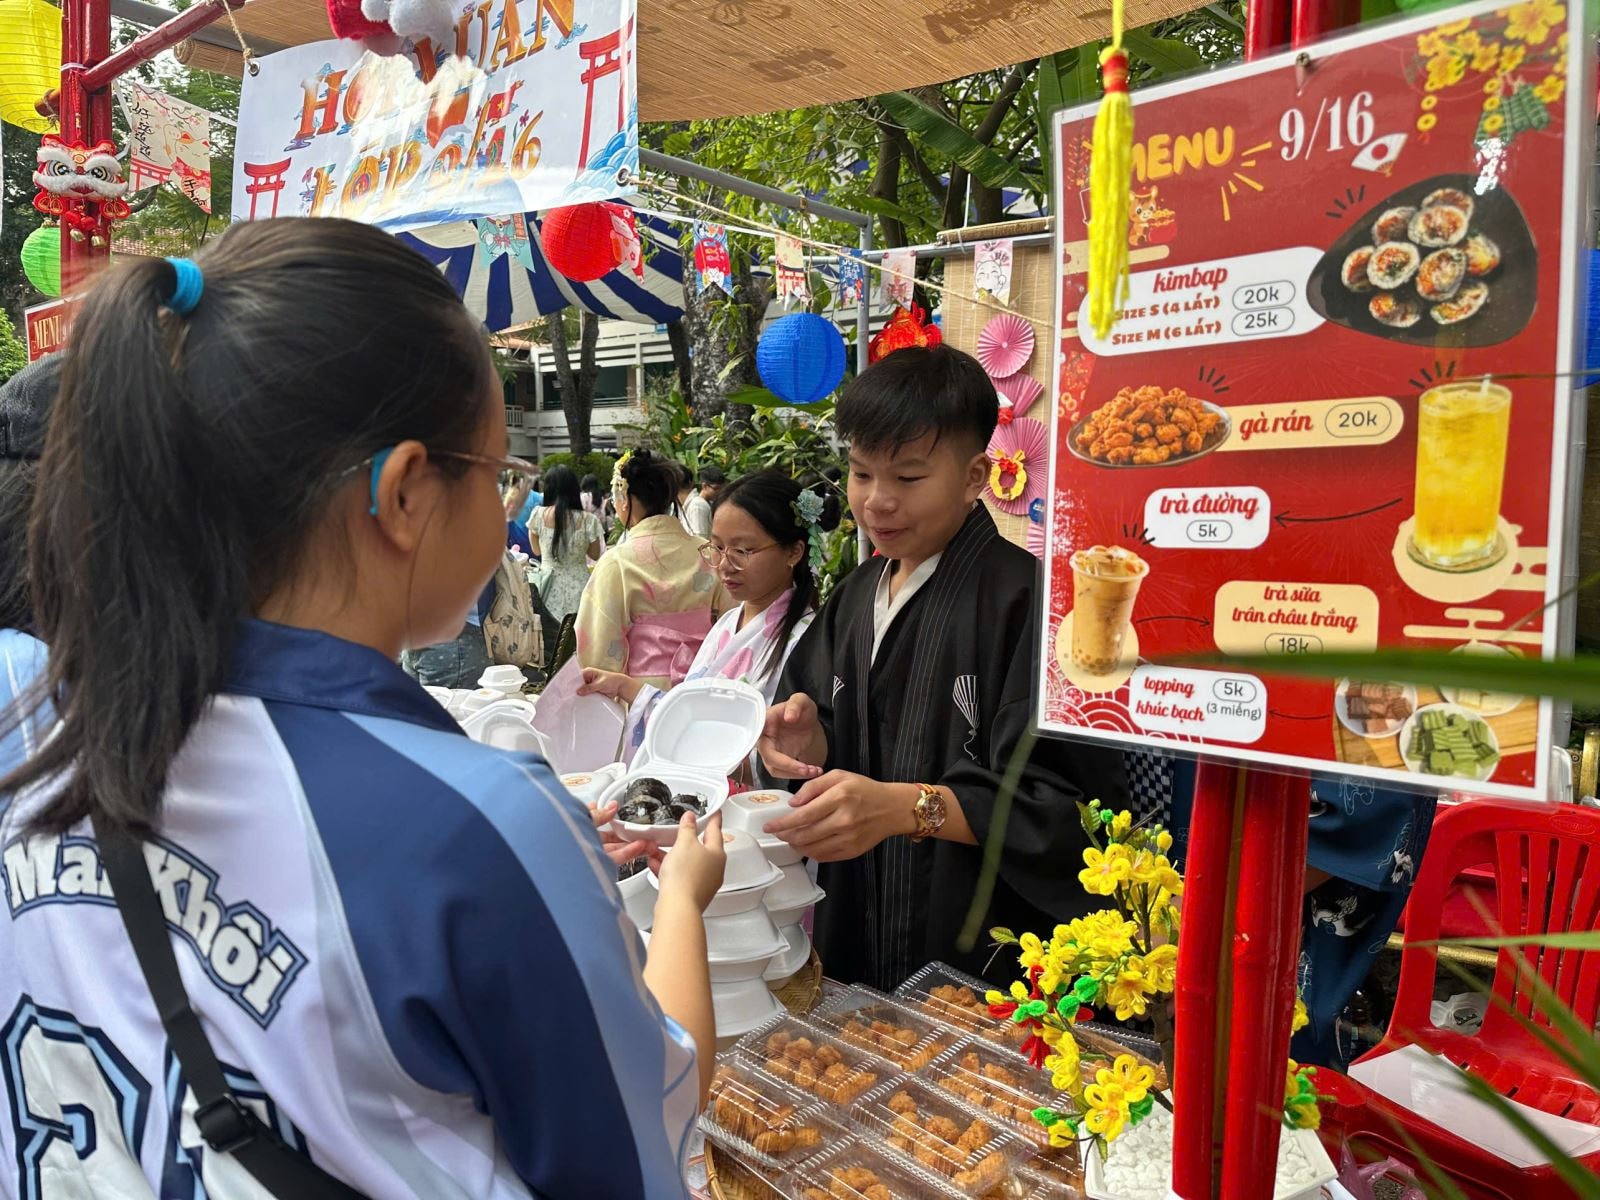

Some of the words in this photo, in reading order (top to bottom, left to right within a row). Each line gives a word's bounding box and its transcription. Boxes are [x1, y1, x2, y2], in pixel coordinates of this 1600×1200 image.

[1279, 91, 1375, 161] 9/16
[1152, 266, 1229, 293] kimbap
[1113, 308, 1146, 321] SIZE
[1149, 304, 1160, 316] S
[1162, 302, 1180, 316] (4
[1183, 292, 1221, 311] LÁT)
[1244, 287, 1279, 305] 20k
[1111, 332, 1144, 346] SIZE
[1146, 329, 1161, 341] M
[1164, 326, 1182, 340] (6
[1185, 317, 1222, 337] LÁT)
[1244, 312, 1278, 329] 25k
[1239, 412, 1269, 440] gà
[1271, 410, 1313, 433] rán
[1338, 411, 1378, 428] 20k
[1159, 488, 1190, 514] trà
[1192, 491, 1259, 519] đường
[1198, 524, 1217, 537] 5k
[1263, 585, 1287, 601] trà
[1290, 587, 1321, 602] sữa
[1232, 607, 1266, 623] trân
[1268, 608, 1308, 625] châu
[1310, 609, 1358, 633] trắng
[1279, 637, 1309, 654] 18k
[1144, 676, 1194, 698] topping
[1223, 681, 1243, 696] 5k
[1136, 699, 1169, 717] khúc
[1171, 702, 1205, 724] bạch
[1207, 702, 1217, 714] (3
[1220, 701, 1262, 721] miếng)
